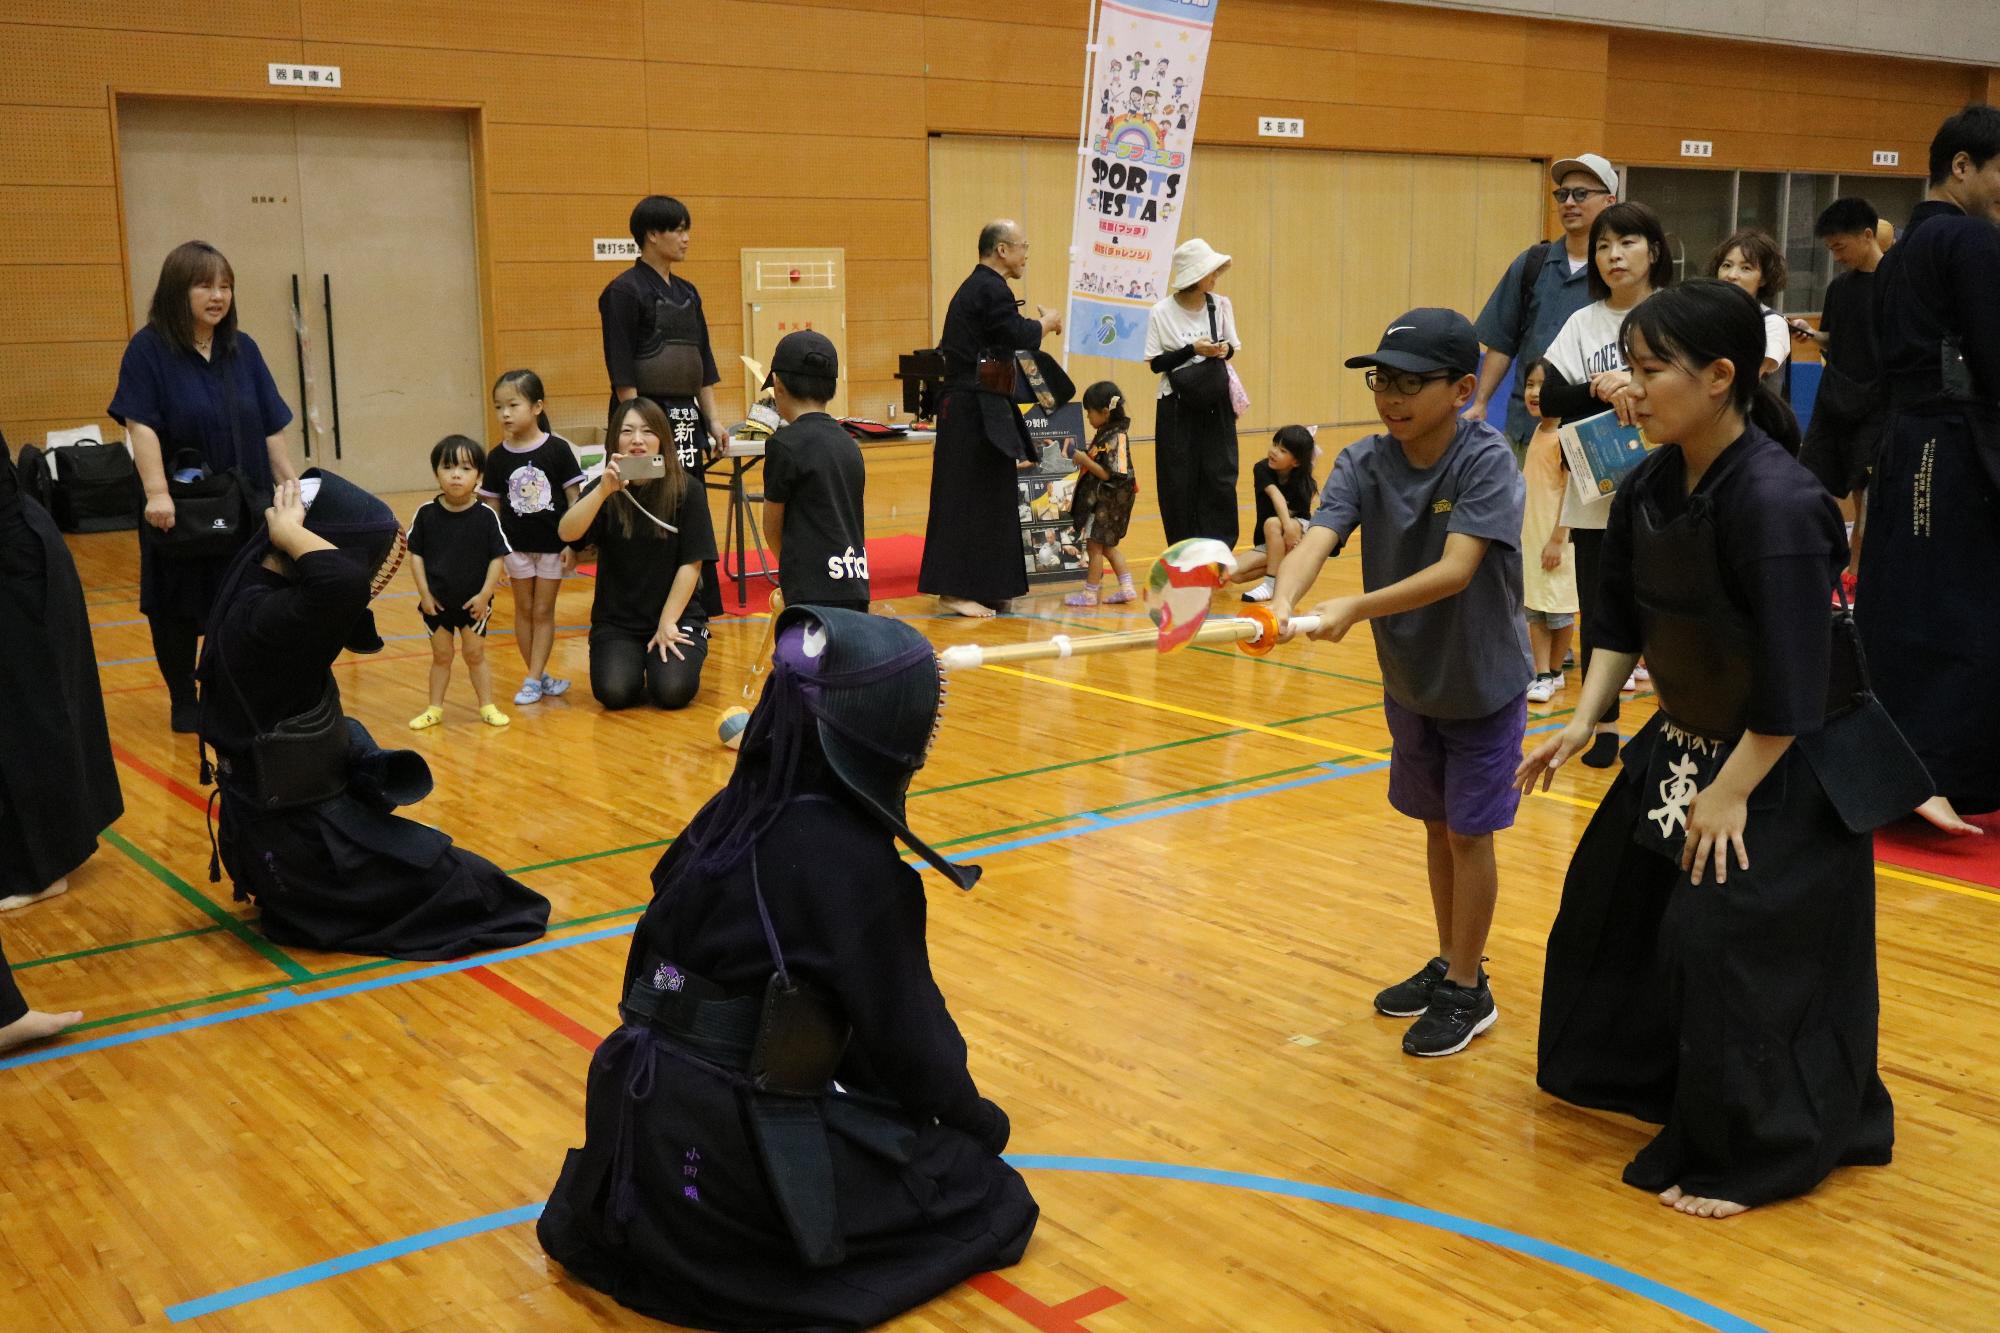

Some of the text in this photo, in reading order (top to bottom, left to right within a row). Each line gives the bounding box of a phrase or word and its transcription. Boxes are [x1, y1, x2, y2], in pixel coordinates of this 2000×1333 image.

[1264, 121, 1298, 135] 本部席
[1685, 143, 1709, 155] 放送室
[1112, 236, 1118, 244] &
[669, 407, 699, 421] 鹿児島
[674, 421, 698, 468] 新村
